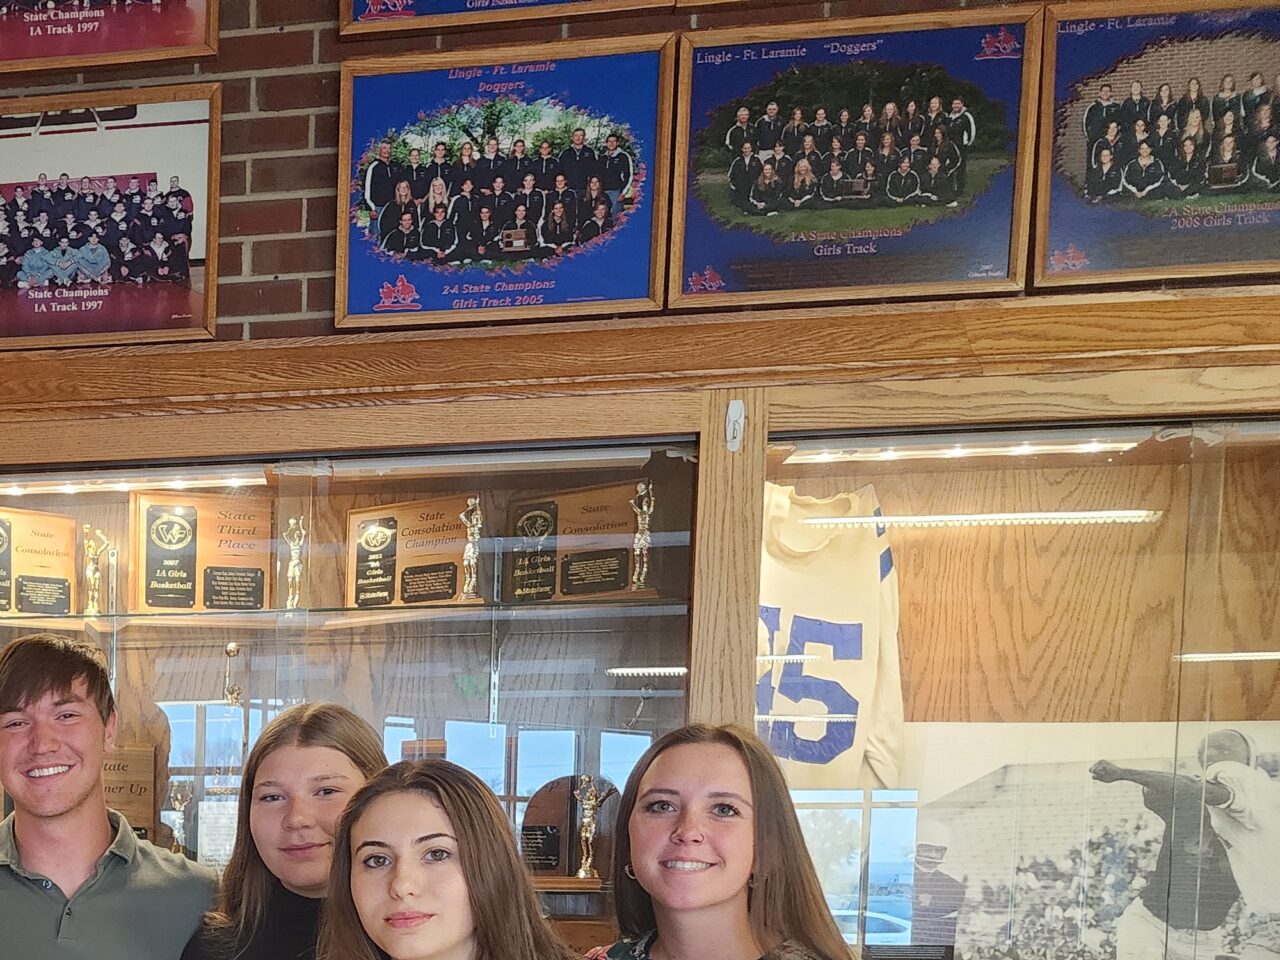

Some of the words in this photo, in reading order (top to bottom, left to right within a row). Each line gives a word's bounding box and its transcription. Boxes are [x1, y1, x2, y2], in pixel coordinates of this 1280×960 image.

[23, 12, 48, 22] State
[50, 9, 105, 21] Champions
[45, 24, 73, 35] Track
[77, 22, 99, 33] 1997
[1057, 21, 1096, 35] Lingle
[1127, 15, 1177, 28] Laramie
[697, 51, 733, 65] Lingle
[761, 46, 807, 59] Laramie
[448, 67, 482, 80] Lingle
[511, 61, 556, 74] Laramie
[478, 79, 525, 93] Doggers
[1182, 204, 1212, 216] State
[1204, 215, 1232, 228] Girls
[1235, 213, 1269, 226] Track
[814, 244, 841, 256] Girls
[845, 243, 877, 255] Track
[28, 289, 53, 299] State
[54, 287, 109, 299] Champions
[463, 283, 491, 294] State
[494, 279, 556, 293] Champions
[50, 301, 78, 312] Track
[81, 300, 103, 311] 1997
[452, 298, 478, 309] Girls
[481, 296, 513, 308] Track
[515, 295, 544, 306] 2005
[217, 510, 256, 521] State
[580, 504, 610, 514] State
[419, 511, 445, 523] State
[217, 525, 256, 536] Third
[401, 523, 462, 537] Consolation
[562, 520, 628, 536] Consolation
[218, 539, 256, 550] Place
[405, 536, 458, 549] Champion
[168, 569, 187, 578] Girls
[150, 580, 193, 590] Basketball
[104, 761, 129, 772] tate
[104, 785, 125, 794] ner
[129, 783, 147, 796] Up
